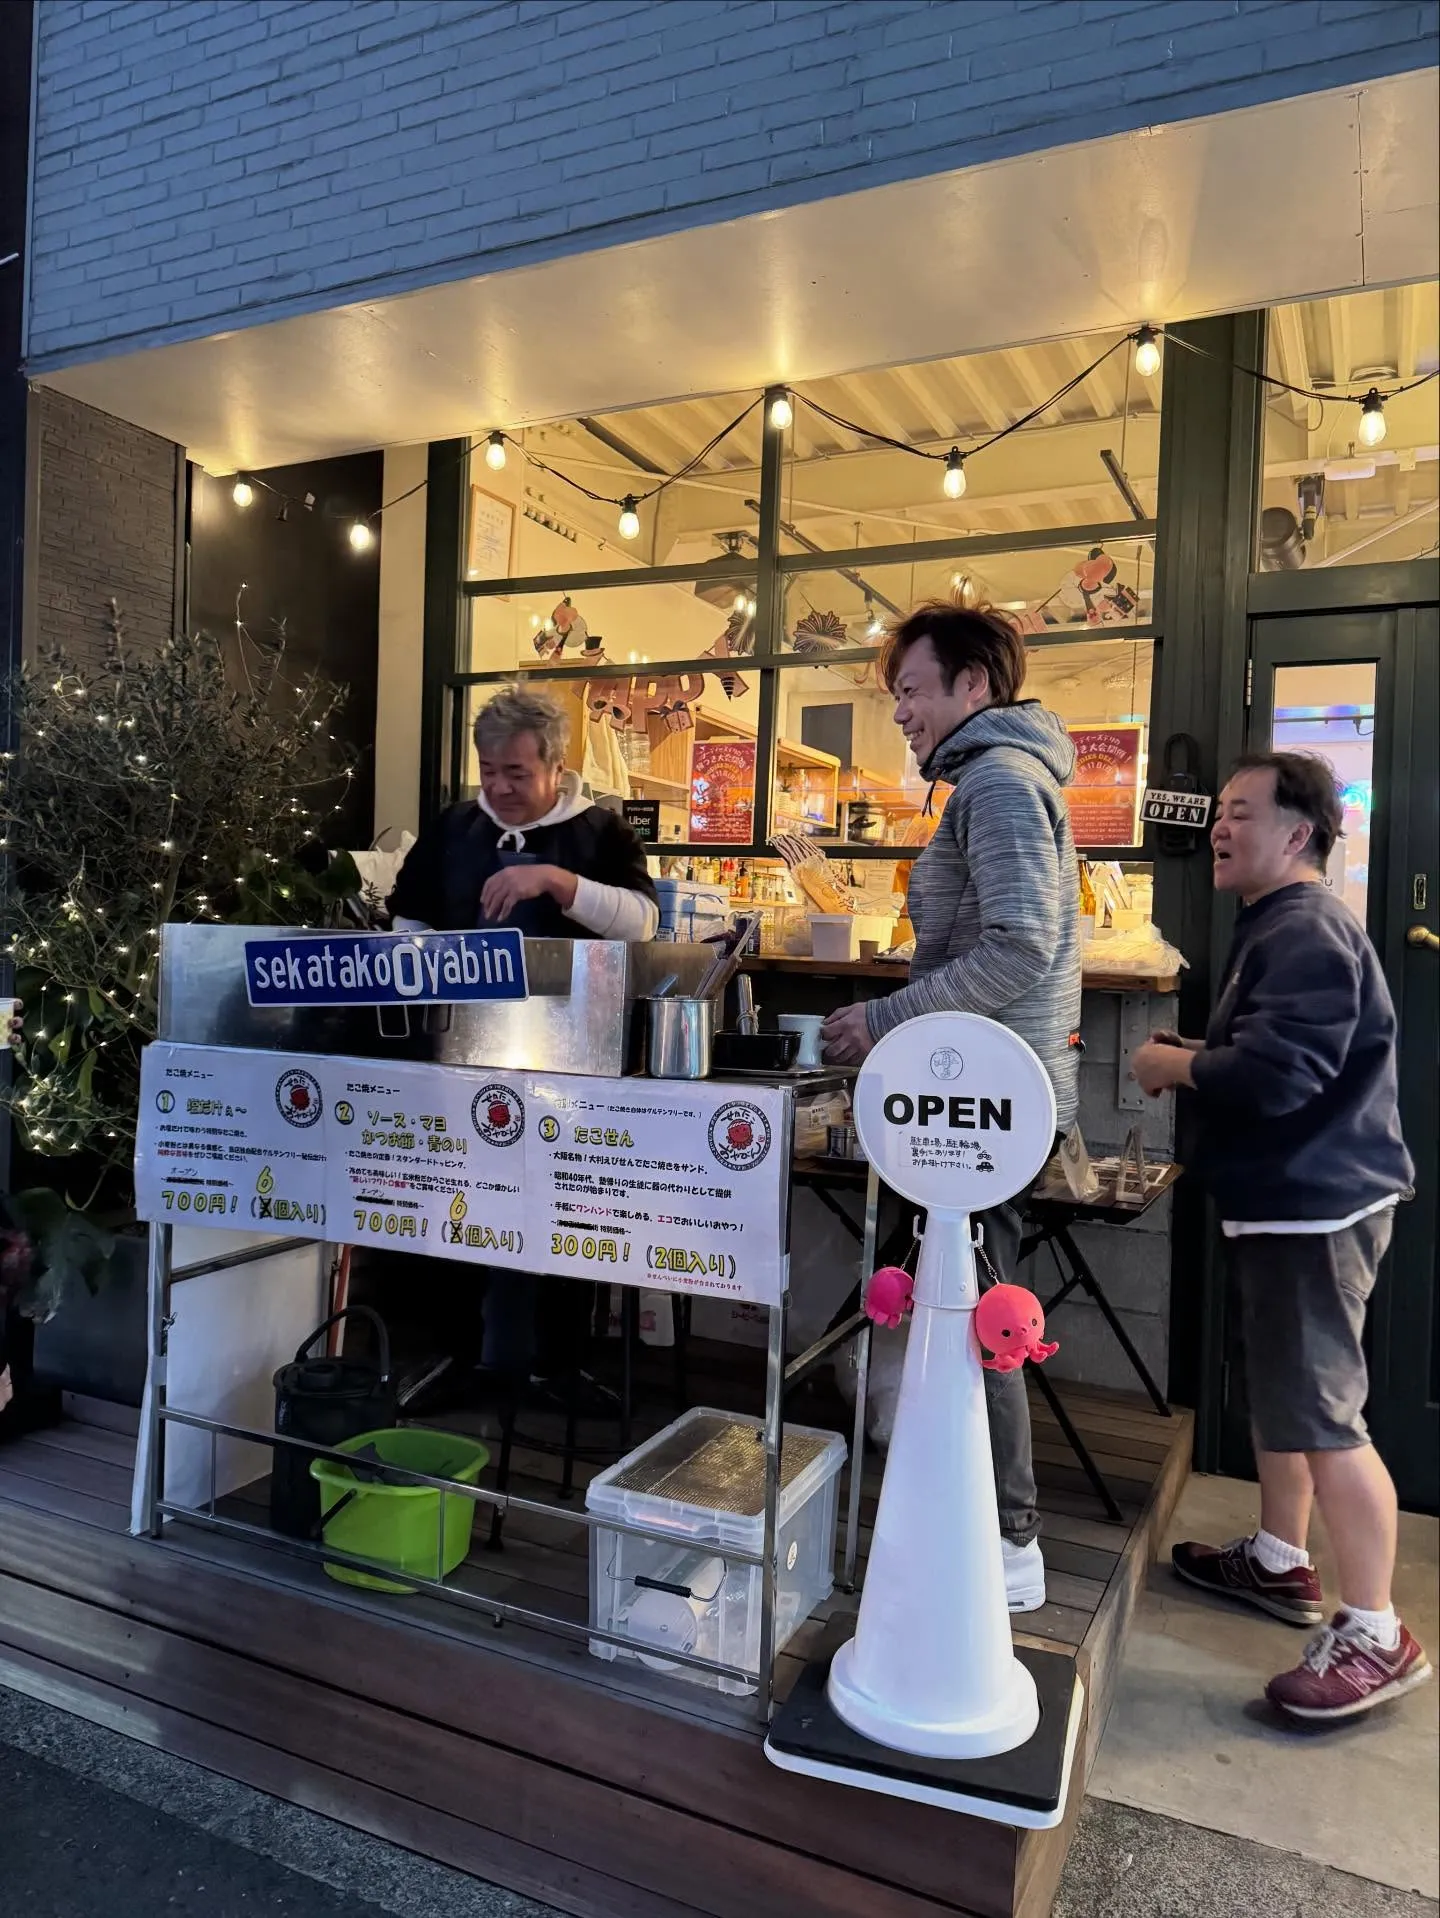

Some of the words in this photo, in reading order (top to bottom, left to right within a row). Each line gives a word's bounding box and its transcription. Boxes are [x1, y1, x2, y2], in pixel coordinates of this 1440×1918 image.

[1150, 792, 1170, 802] YES,
[1172, 794, 1187, 804] WE
[1187, 797, 1206, 806] ARE
[628, 816, 651, 825] Uber
[1149, 803, 1200, 822] OPEN
[634, 827, 651, 836] ats
[346, 1083, 400, 1095] たこ焼メニュー
[367, 1110, 447, 1132] ソース・マヨ
[883, 1093, 1012, 1131] OPEN
[361, 1128, 468, 1154] かつお節・青のり
[574, 1125, 635, 1148] たこせん
[256, 1165, 274, 1195] 6
[162, 1191, 239, 1214] 700円！
[449, 1190, 468, 1221] 6
[354, 1210, 428, 1238] 700円！
[551, 1233, 630, 1262] 300円！
[646, 1245, 737, 1279] (2個入り)
